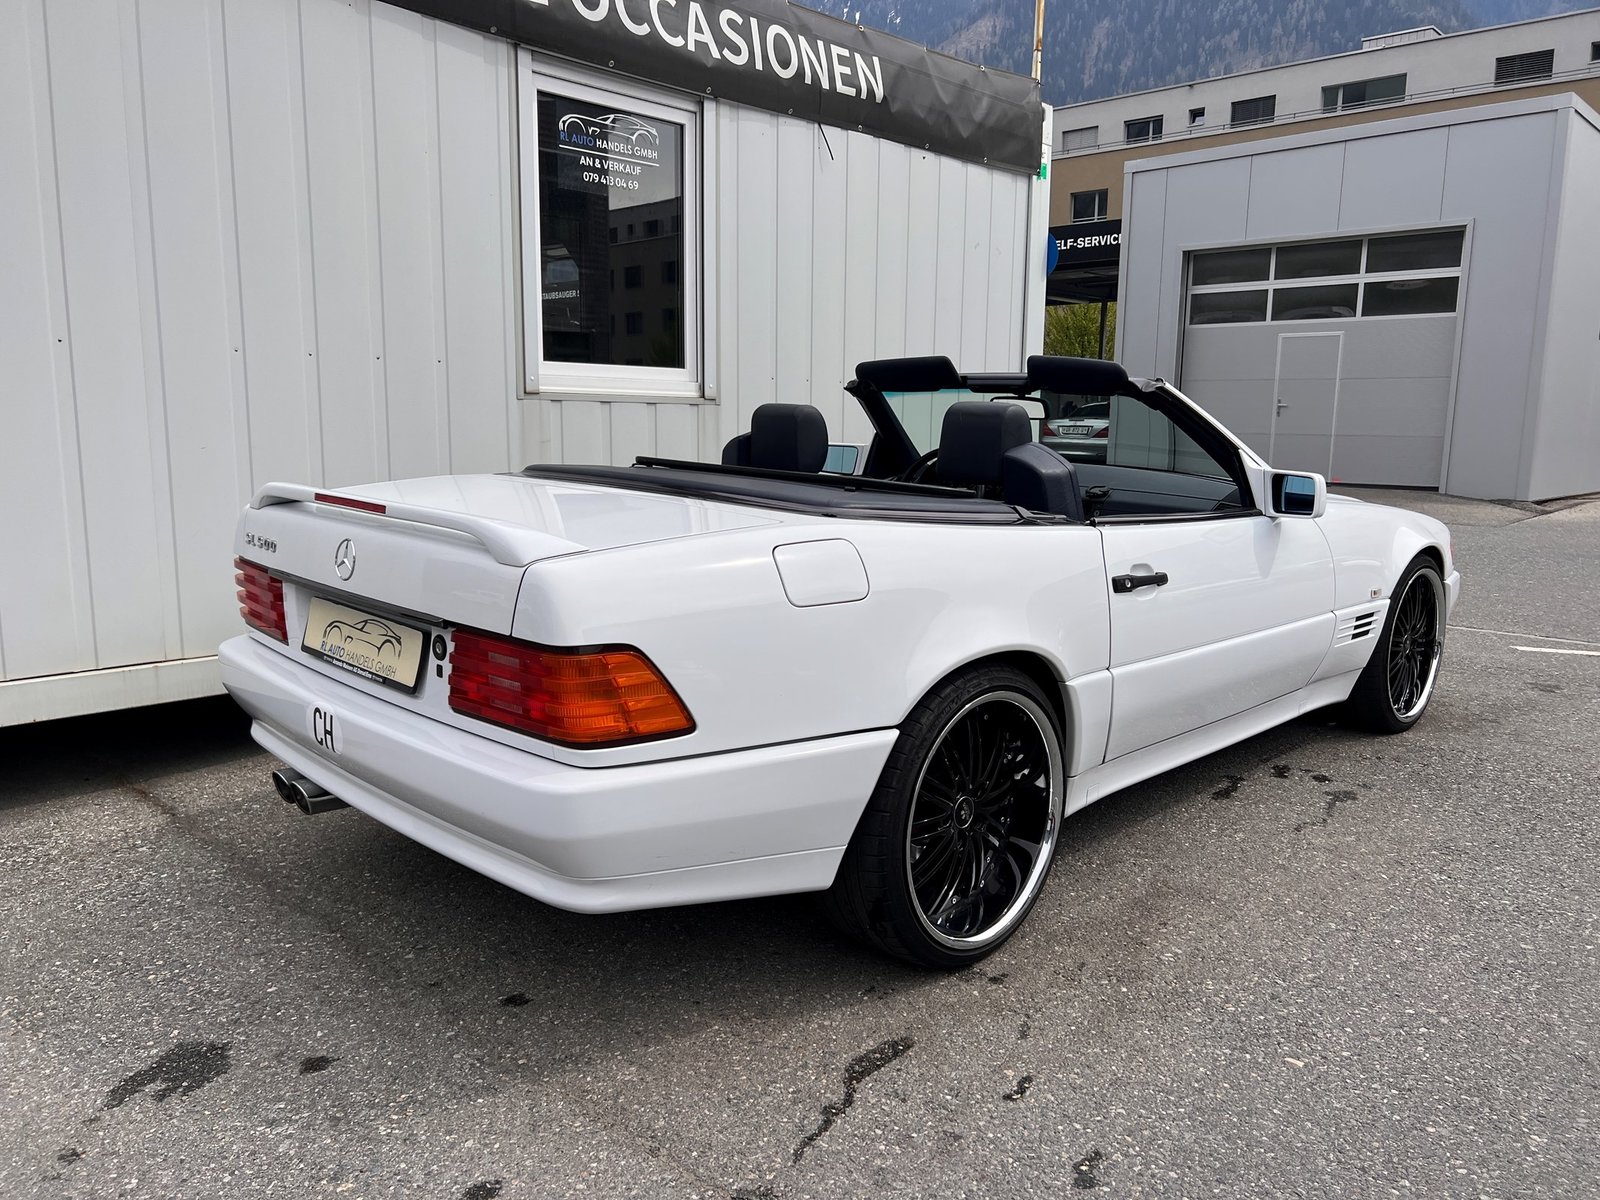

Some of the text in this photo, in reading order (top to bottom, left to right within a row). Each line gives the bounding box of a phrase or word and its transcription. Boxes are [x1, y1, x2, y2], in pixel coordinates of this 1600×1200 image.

[560, 131, 658, 159] RL AUTO HANDELS GMBH
[580, 155, 642, 175] AN & VERKAUF
[583, 172, 639, 190] 079 413 04 69
[1055, 234, 1121, 250] ELF-SERVIC
[320, 641, 327, 653] RL
[327, 641, 346, 658] AUTO
[345, 649, 375, 670] HANDELS
[374, 660, 398, 679] GMBH
[312, 706, 336, 752] CH
